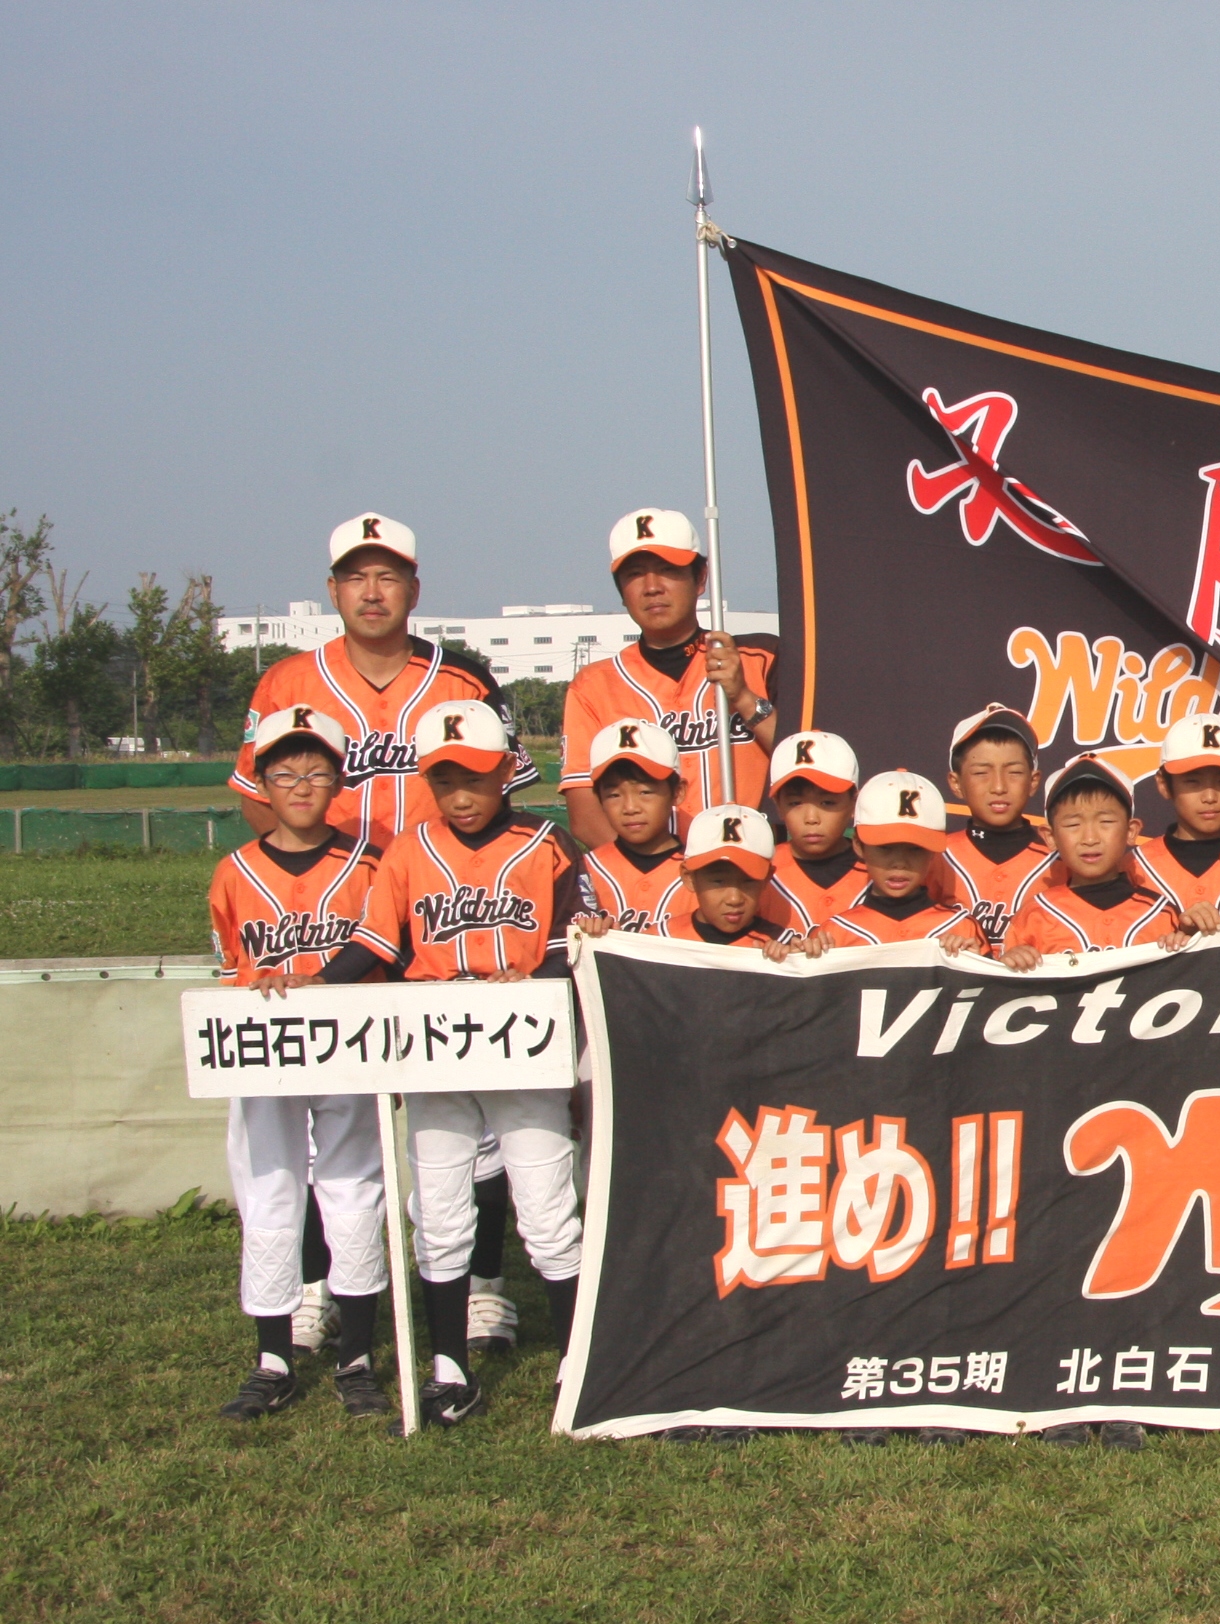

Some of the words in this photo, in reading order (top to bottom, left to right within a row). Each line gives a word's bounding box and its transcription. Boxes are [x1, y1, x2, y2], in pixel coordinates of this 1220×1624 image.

[362, 518, 380, 539] K
[636, 515, 654, 540] K
[292, 707, 313, 729] K
[443, 715, 463, 742] K
[619, 725, 638, 749] K
[1202, 724, 1220, 749] K
[795, 740, 814, 765] K
[898, 790, 920, 817] K
[722, 817, 742, 843] K
[414, 885, 539, 944] Wildnine
[198, 1012, 556, 1070] 北白石ワイルドナイン
[841, 1351, 1008, 1400] 第35期
